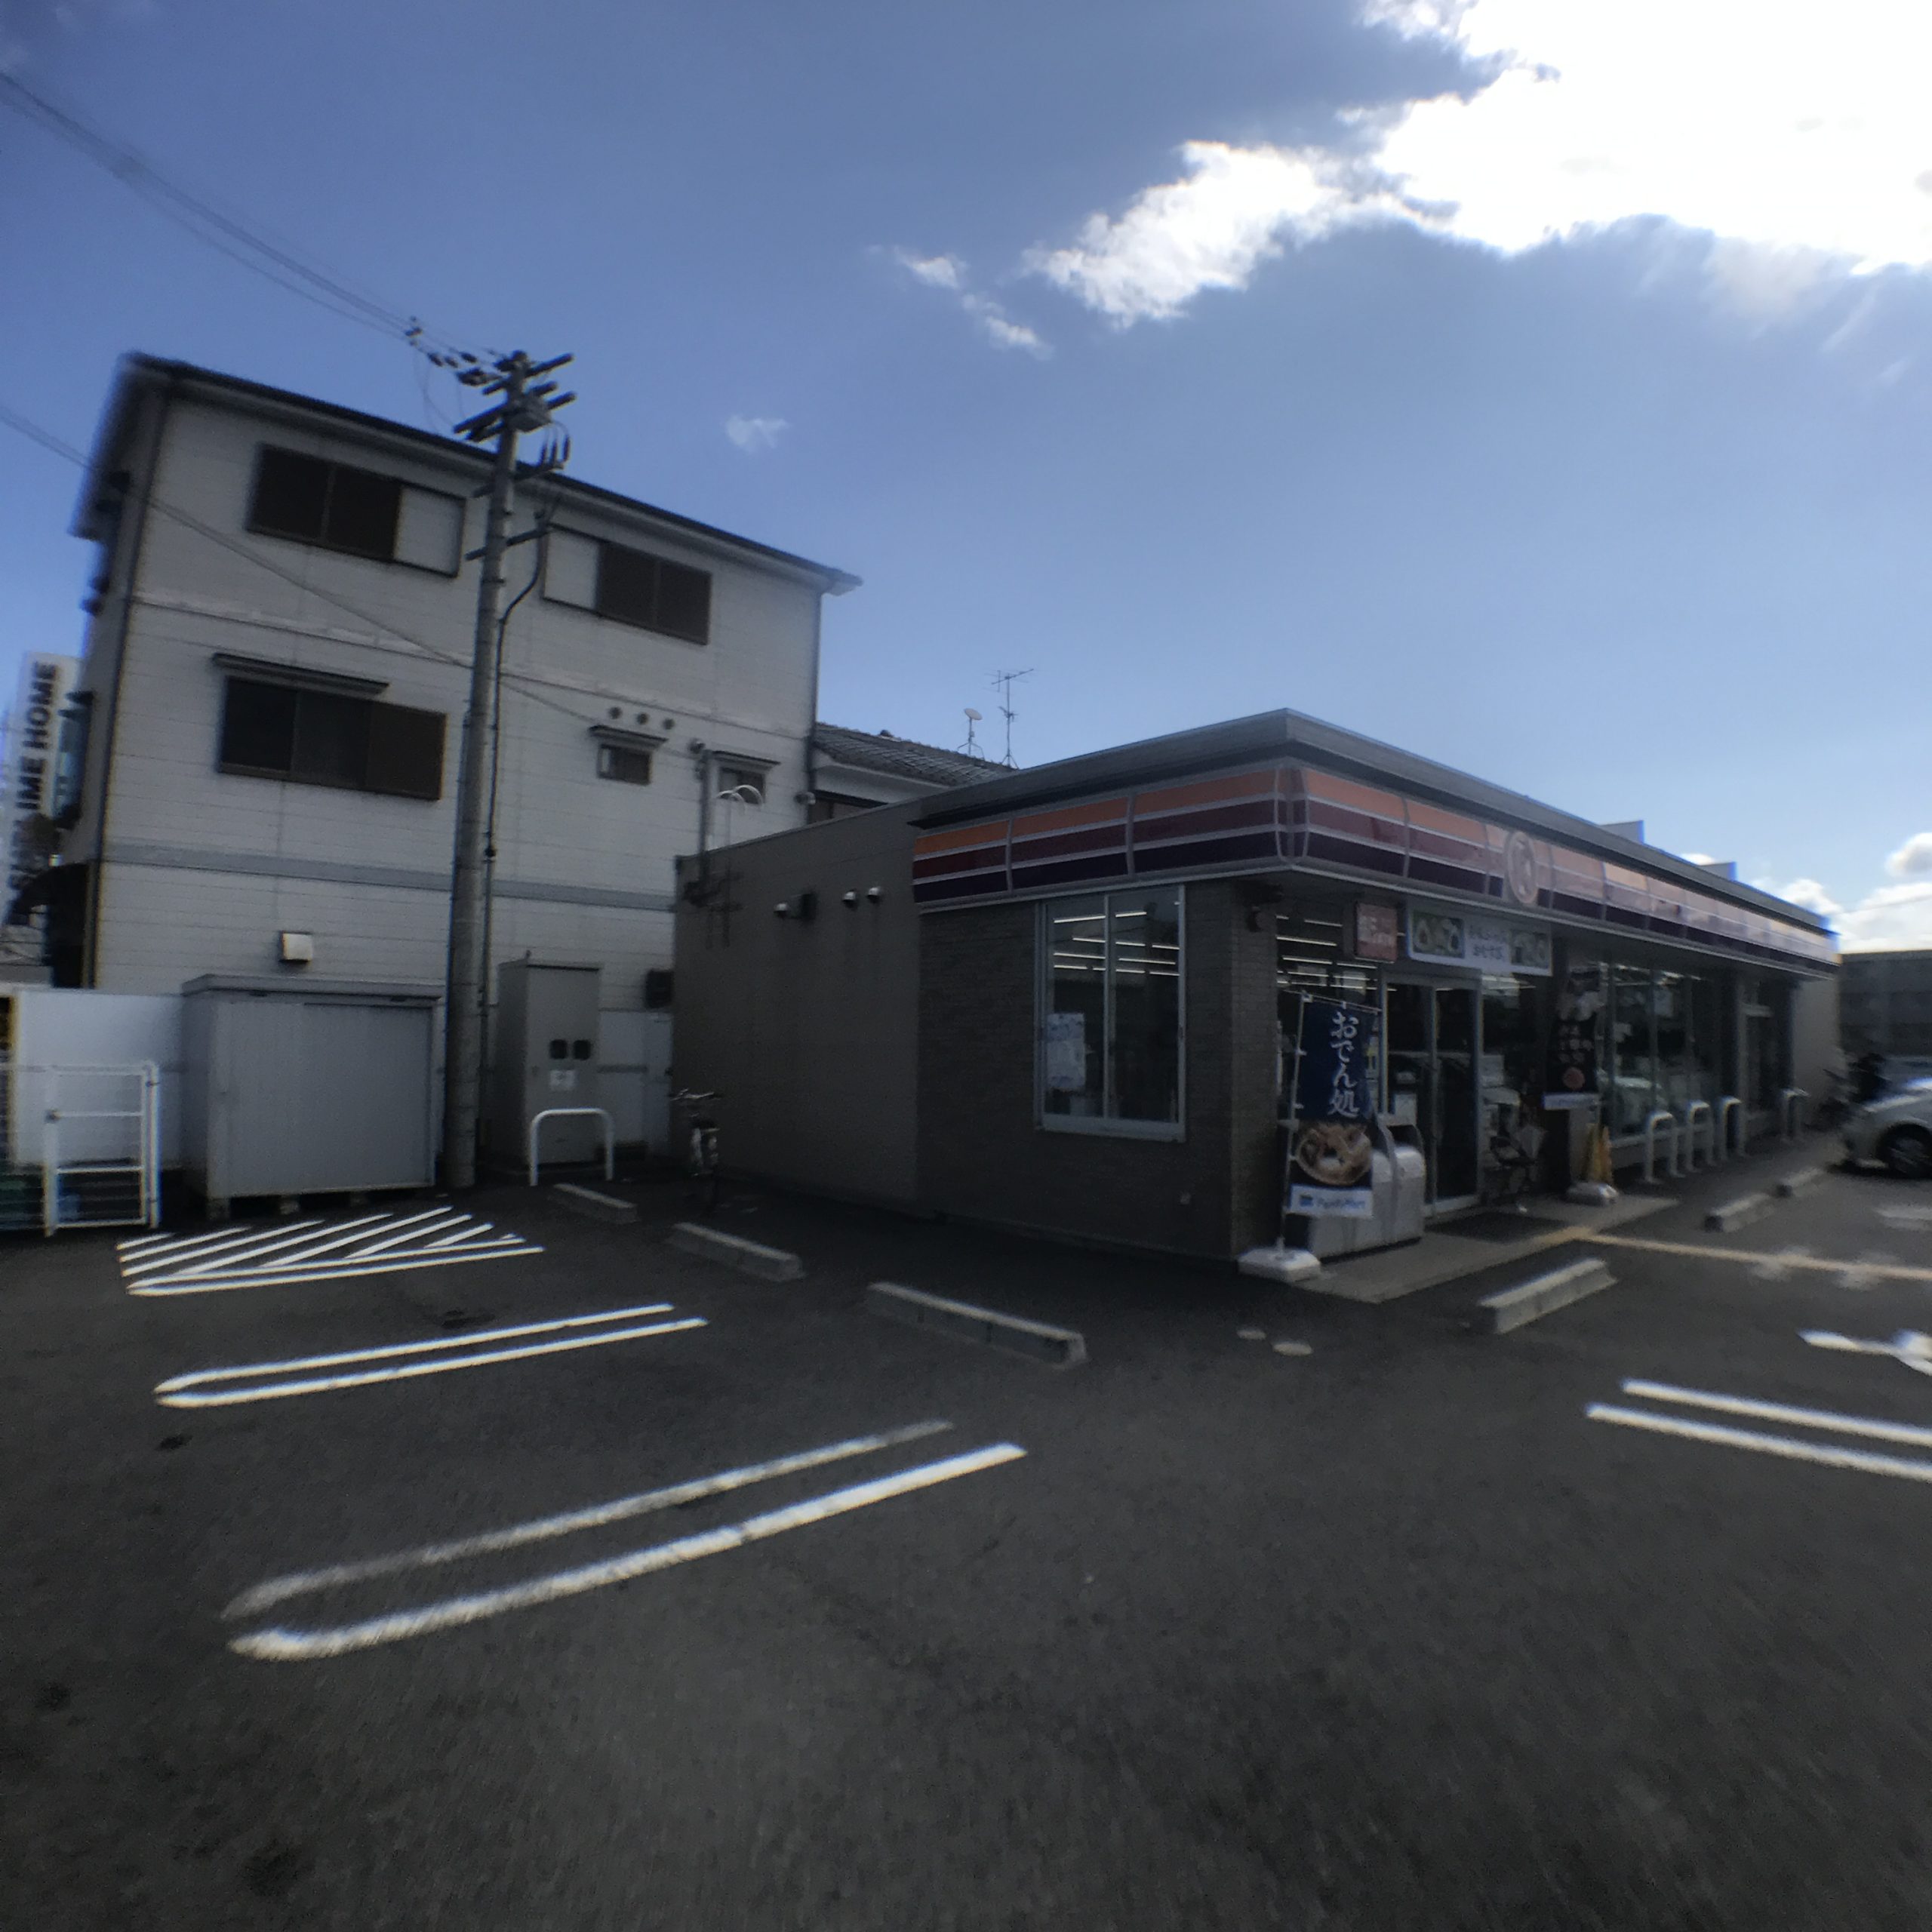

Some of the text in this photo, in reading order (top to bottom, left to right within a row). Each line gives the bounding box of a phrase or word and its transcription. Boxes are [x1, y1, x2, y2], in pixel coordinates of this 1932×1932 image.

[23, 661, 57, 749] HOME
[1327, 1011, 1360, 1118] おでん処
